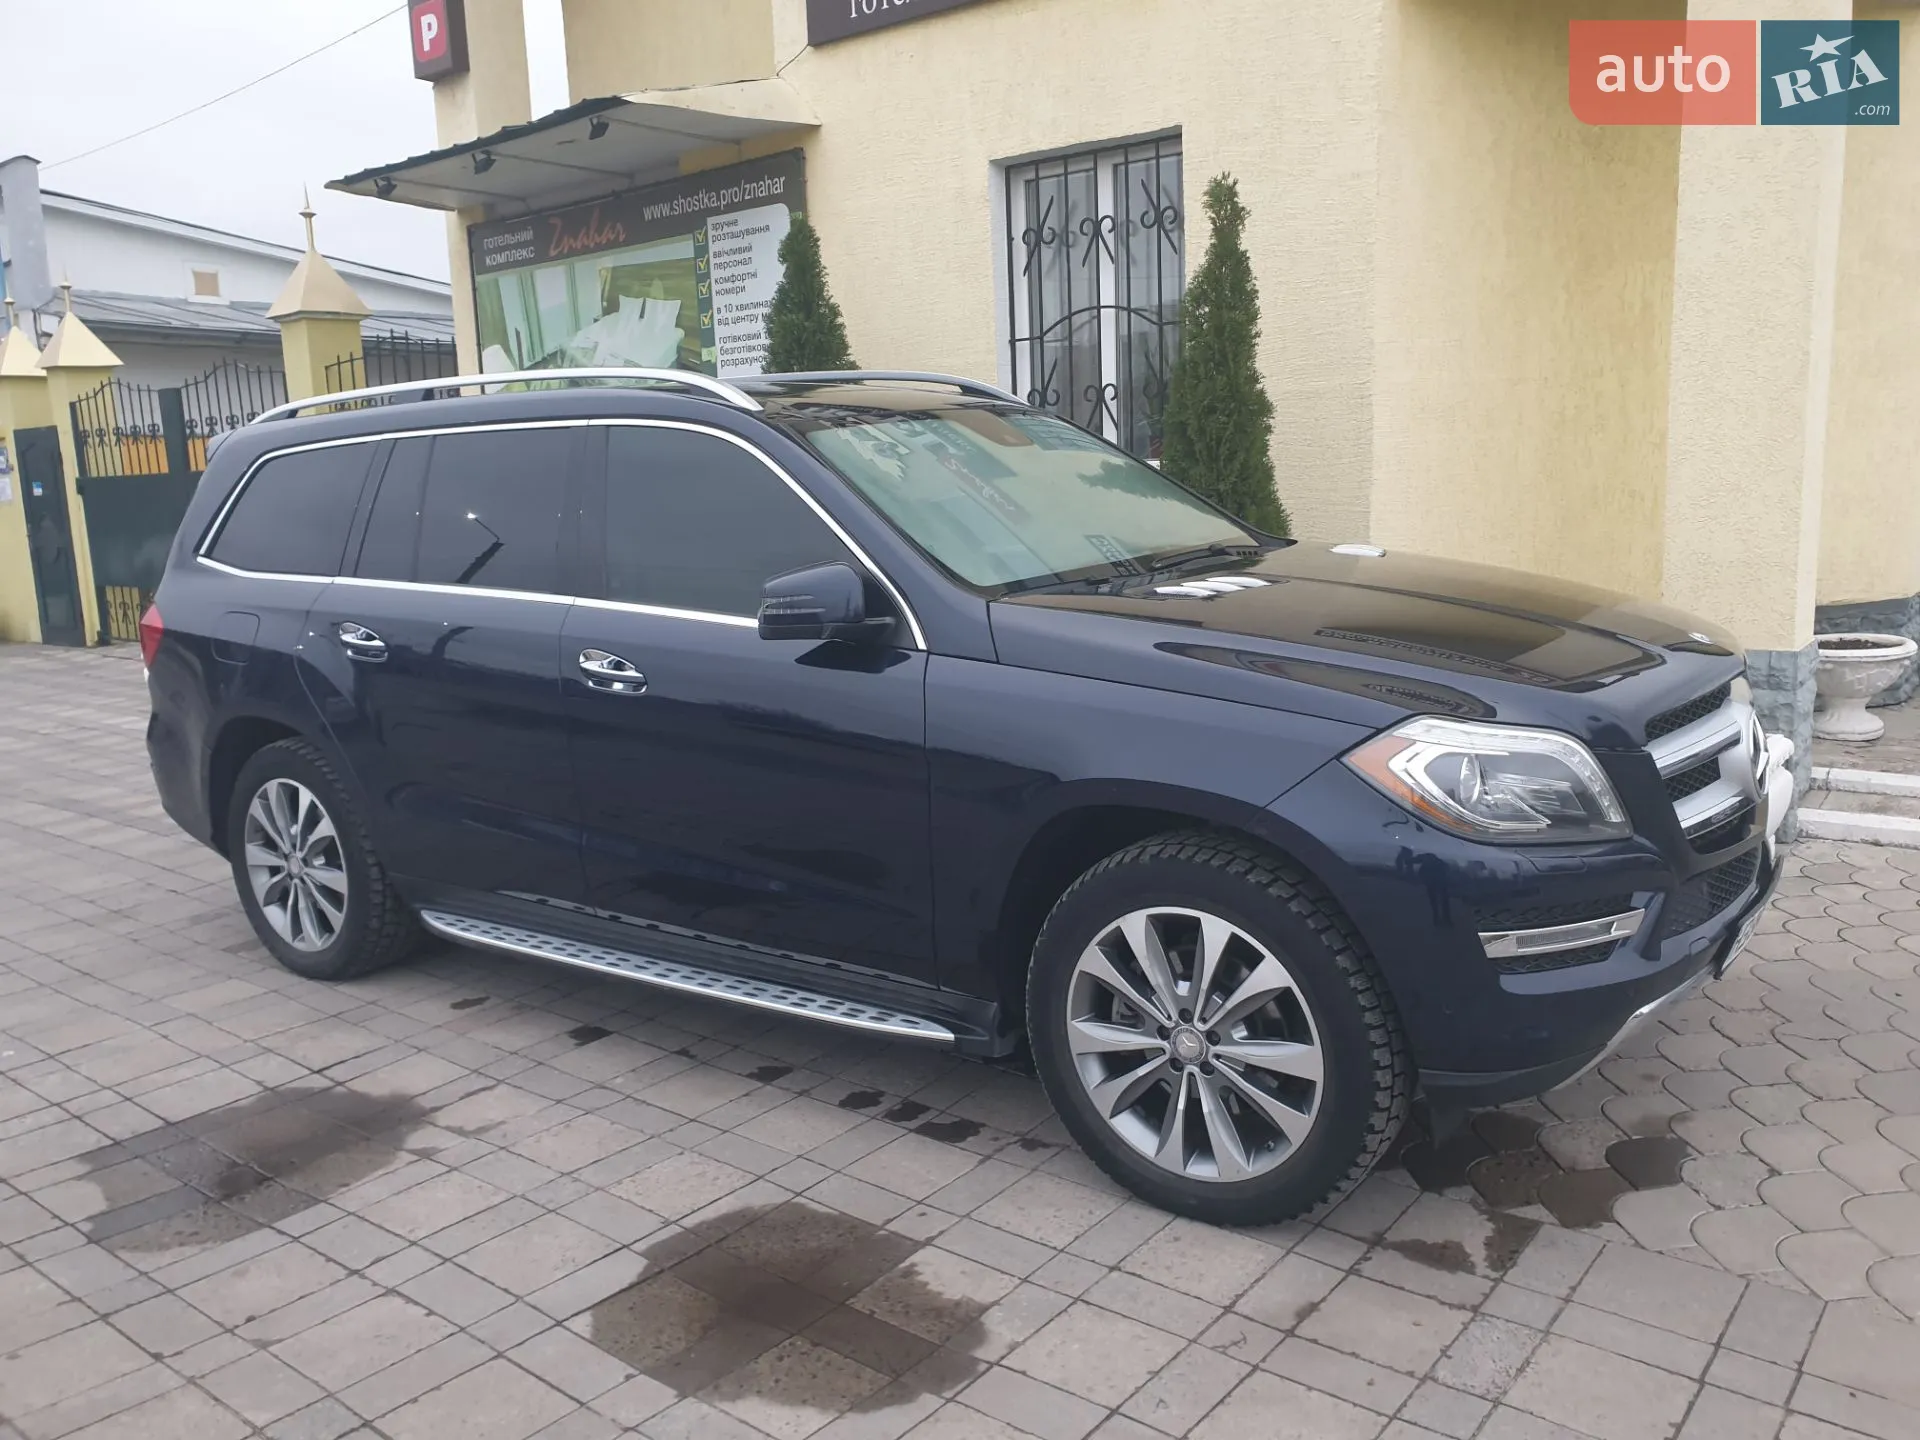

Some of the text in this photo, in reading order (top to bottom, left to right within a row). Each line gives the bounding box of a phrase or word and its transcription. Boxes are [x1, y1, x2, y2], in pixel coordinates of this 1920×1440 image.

[420, 13, 438, 51] P
[643, 175, 785, 221] www.shostka.pro/znahar
[548, 207, 626, 257] Znahar
[711, 219, 738, 232] зручне
[483, 226, 533, 249] готельний
[711, 225, 770, 244] розташування
[485, 247, 535, 266] комплекс
[712, 242, 752, 258] ввічливий
[713, 257, 752, 271] персонал
[714, 269, 757, 284] комфортні
[715, 285, 746, 296] номери
[724, 304, 733, 313] 10
[717, 316, 729, 326] від
[731, 314, 759, 325] центру
[719, 330, 761, 344] готівковий
